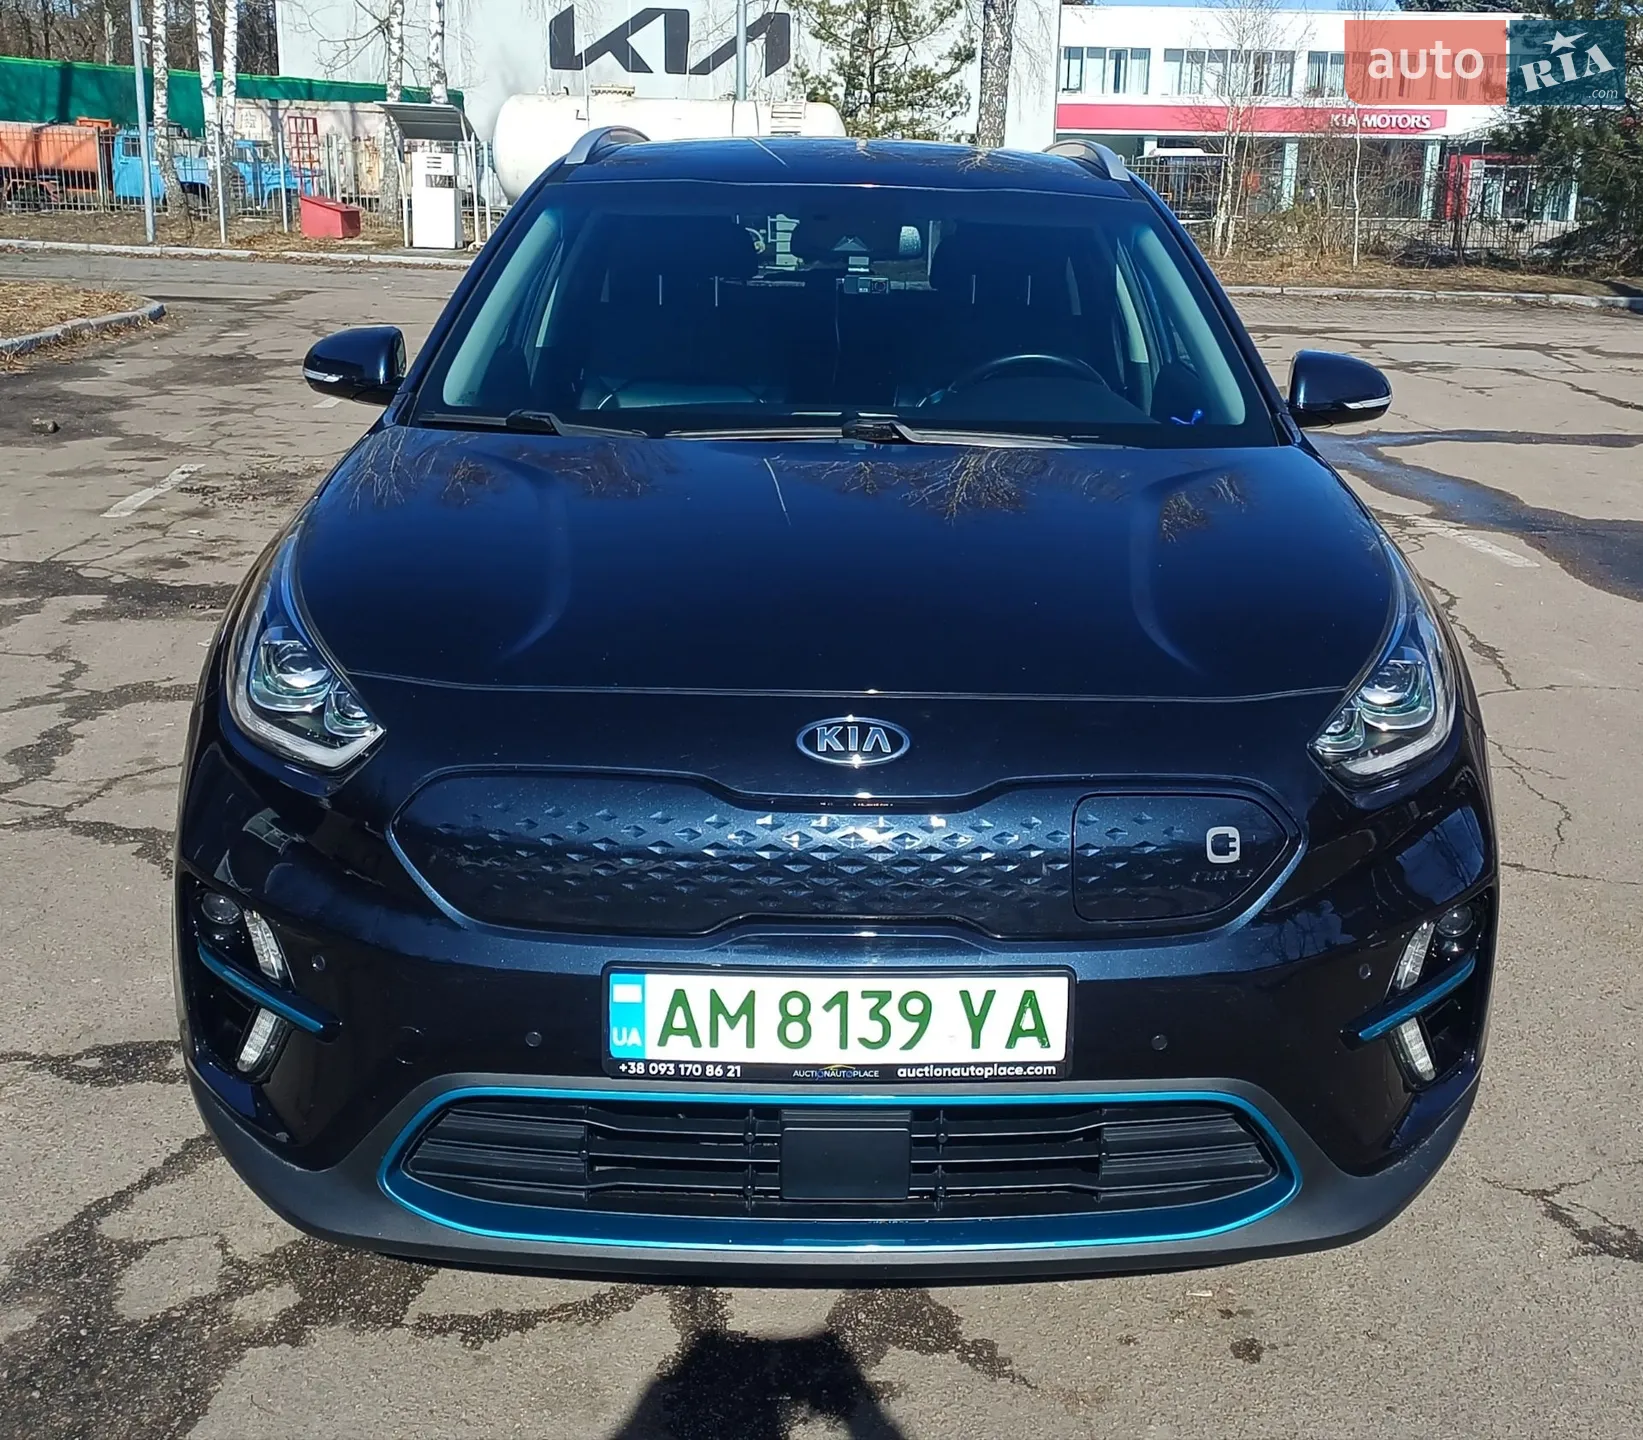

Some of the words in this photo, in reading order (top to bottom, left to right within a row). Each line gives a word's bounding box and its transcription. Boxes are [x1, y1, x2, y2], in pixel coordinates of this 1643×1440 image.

[1330, 113, 1356, 128] KIA
[1362, 113, 1431, 130] MOTORS
[816, 726, 892, 753] KIA
[657, 988, 755, 1049] AM
[777, 990, 933, 1051] 8139
[959, 989, 1052, 1050] YA
[612, 1028, 643, 1047] UA
[619, 1062, 645, 1076] +38
[648, 1062, 677, 1076] 093
[679, 1063, 702, 1077] 170
[703, 1064, 724, 1078] 86
[726, 1064, 741, 1078] 21
[897, 1063, 1057, 1079] auctionautoplace.com
